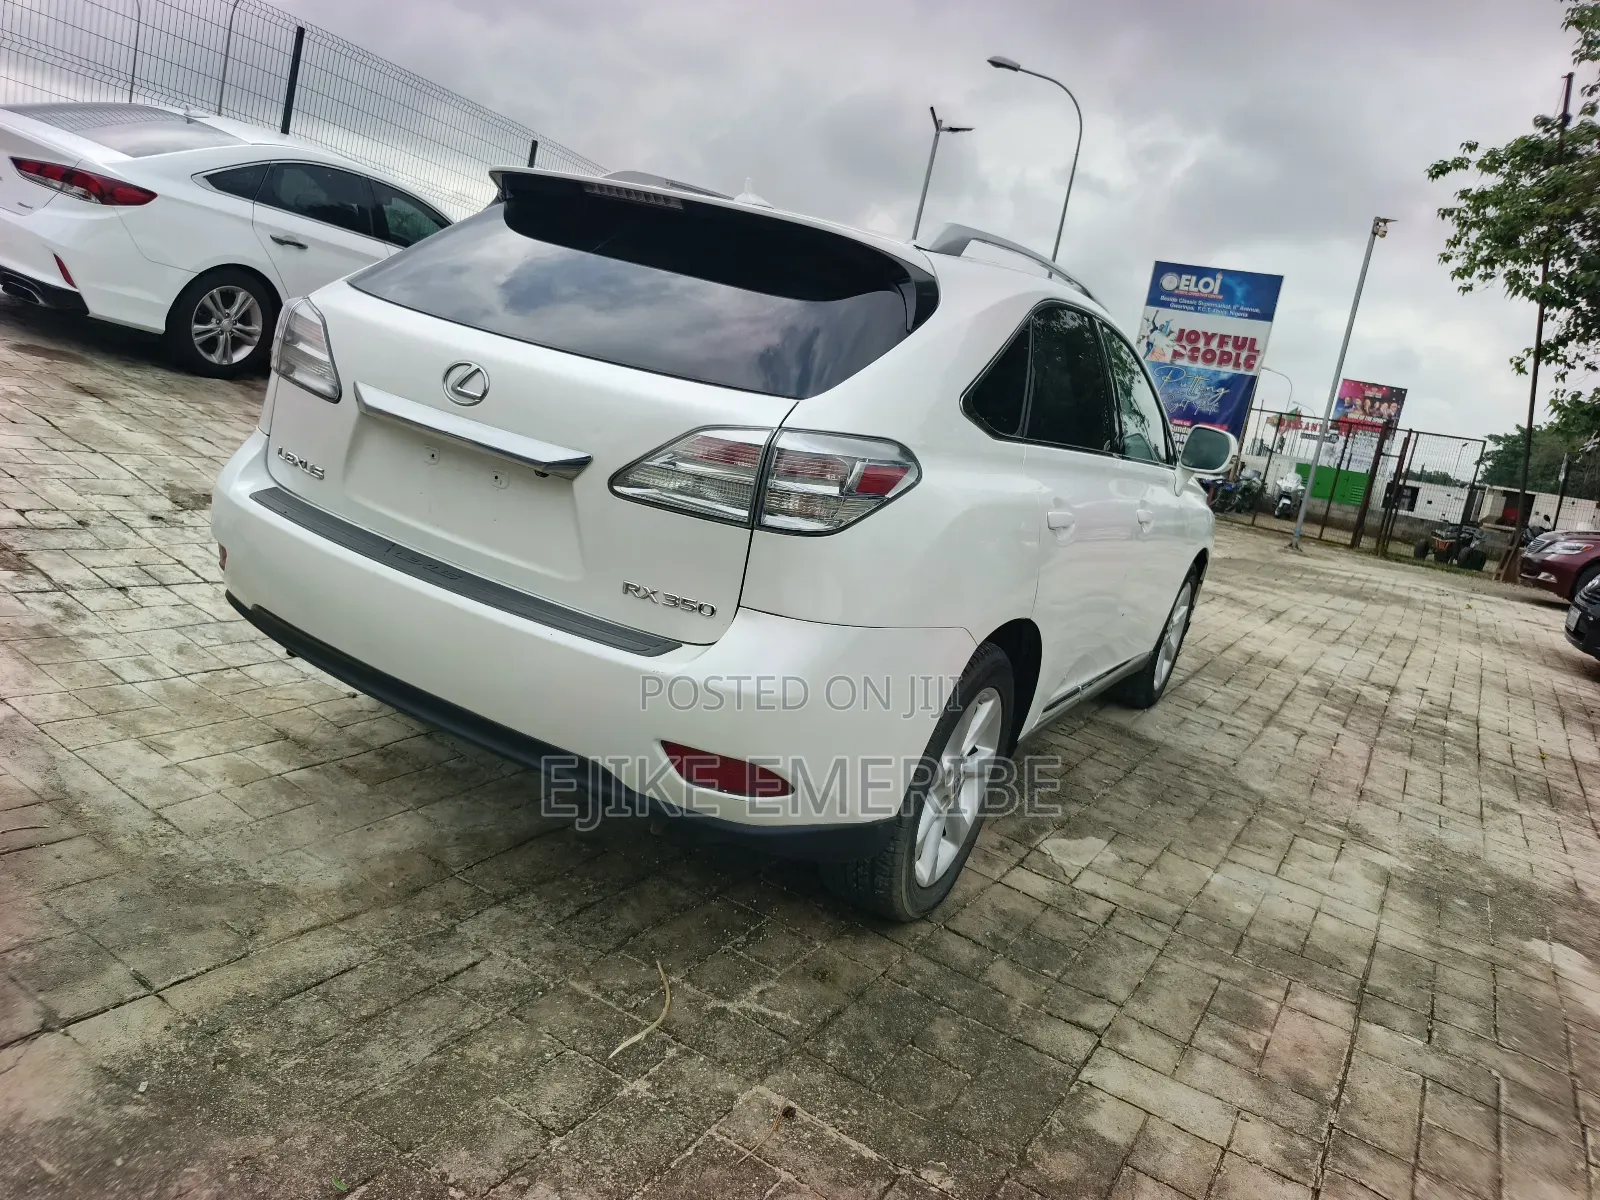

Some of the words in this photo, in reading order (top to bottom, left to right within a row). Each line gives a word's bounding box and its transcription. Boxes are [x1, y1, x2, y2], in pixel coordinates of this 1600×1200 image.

[1175, 328, 1260, 354] JOYFUL
[278, 446, 325, 481] LEXUS
[622, 580, 659, 604] RX
[662, 591, 717, 618] 350
